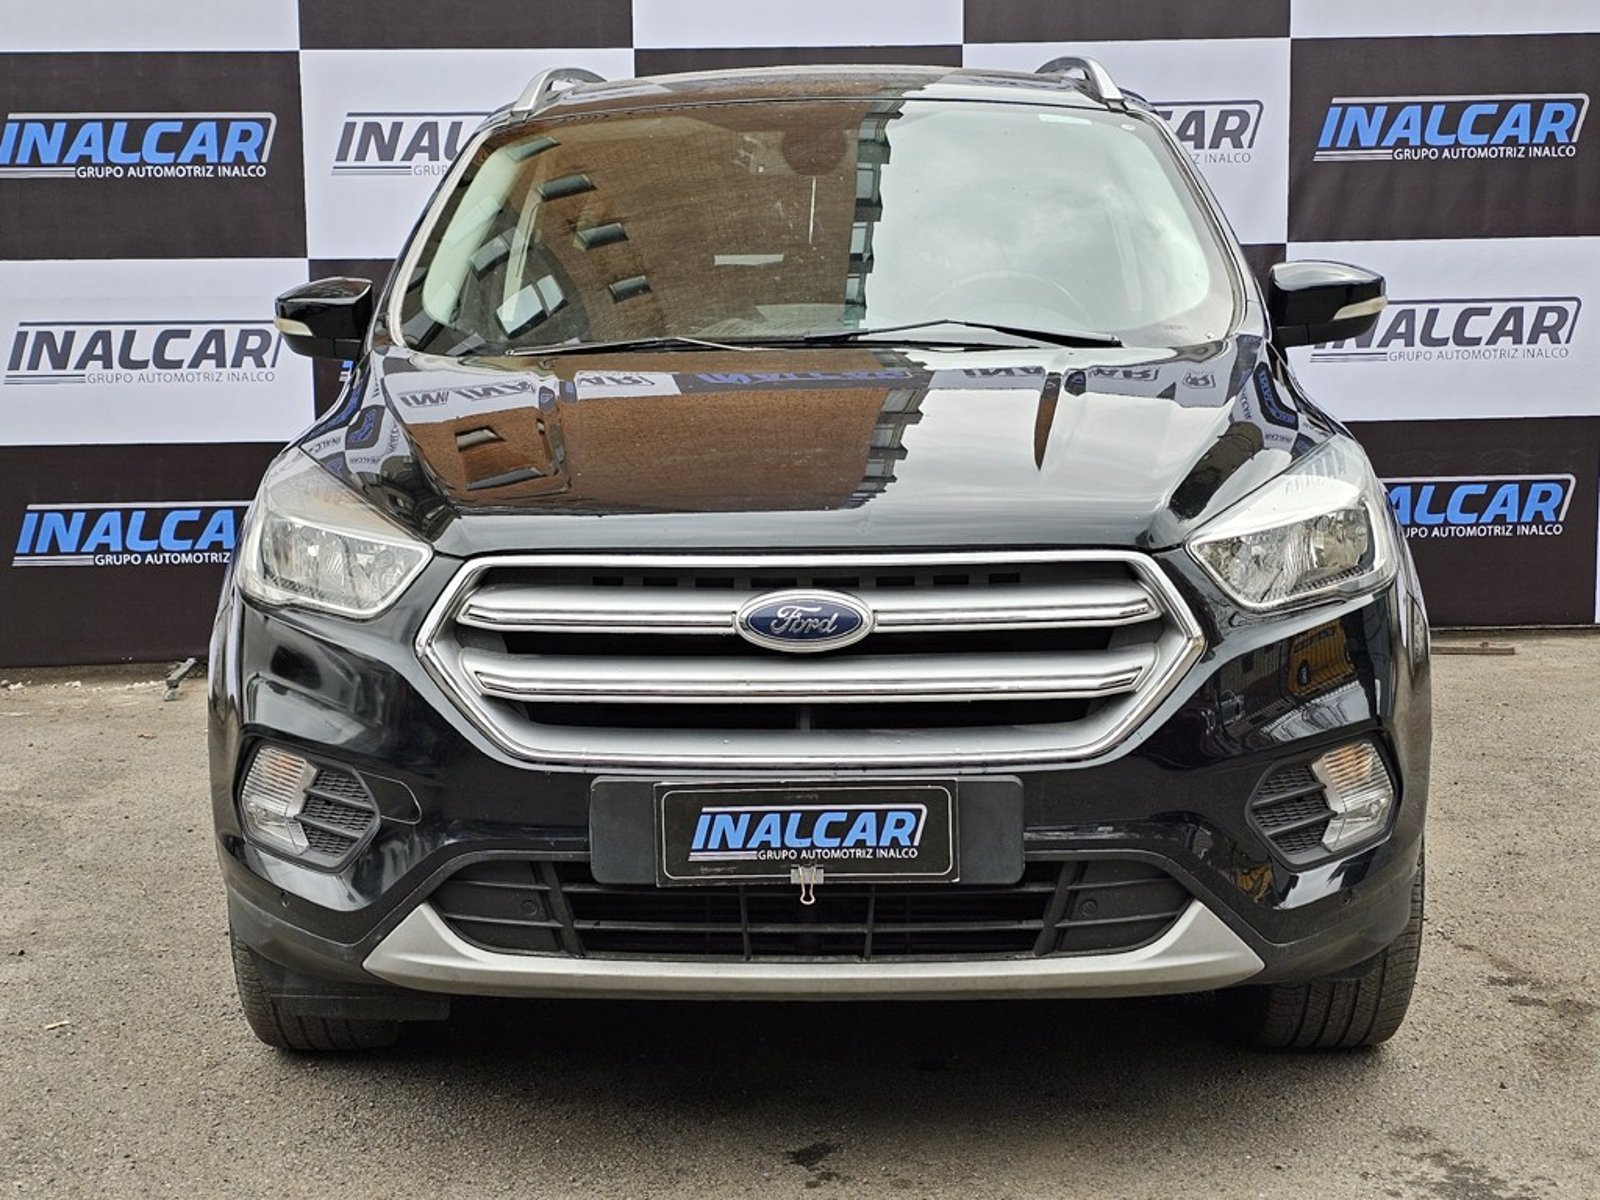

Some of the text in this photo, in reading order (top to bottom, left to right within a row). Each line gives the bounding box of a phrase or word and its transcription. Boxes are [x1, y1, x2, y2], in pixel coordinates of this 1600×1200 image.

[1317, 101, 1578, 148] INALCAR
[0, 121, 265, 164] INALCAR
[335, 121, 463, 162] INAL
[1393, 145, 1576, 160] GRUPO AUTOMOTRIZ INALCO
[1204, 152, 1252, 164] INALCO
[77, 164, 267, 178] GRUPO AUTOMOTRIZ INALCO
[413, 164, 448, 176] GRUP
[1314, 305, 1570, 349] ALCAR
[7, 329, 273, 371] INALCAR
[1388, 347, 1569, 362] GRUPO AUTOMOTRIZ INALCO
[87, 371, 276, 384] GRUPO AUTOMOTRIZ INALCO
[1388, 482, 1563, 525] ALCAR
[15, 509, 237, 554] INALCA
[1431, 525, 1514, 538] AUTOMOTRIZ
[1516, 524, 1563, 537] INALCO
[94, 552, 231, 566] GRUPO AUTOMOTRIZ
[770, 605, 840, 634] Ford
[691, 811, 917, 850] INALCAR
[758, 847, 918, 860] GRUPO AUTOMOTRIZ INALCO
